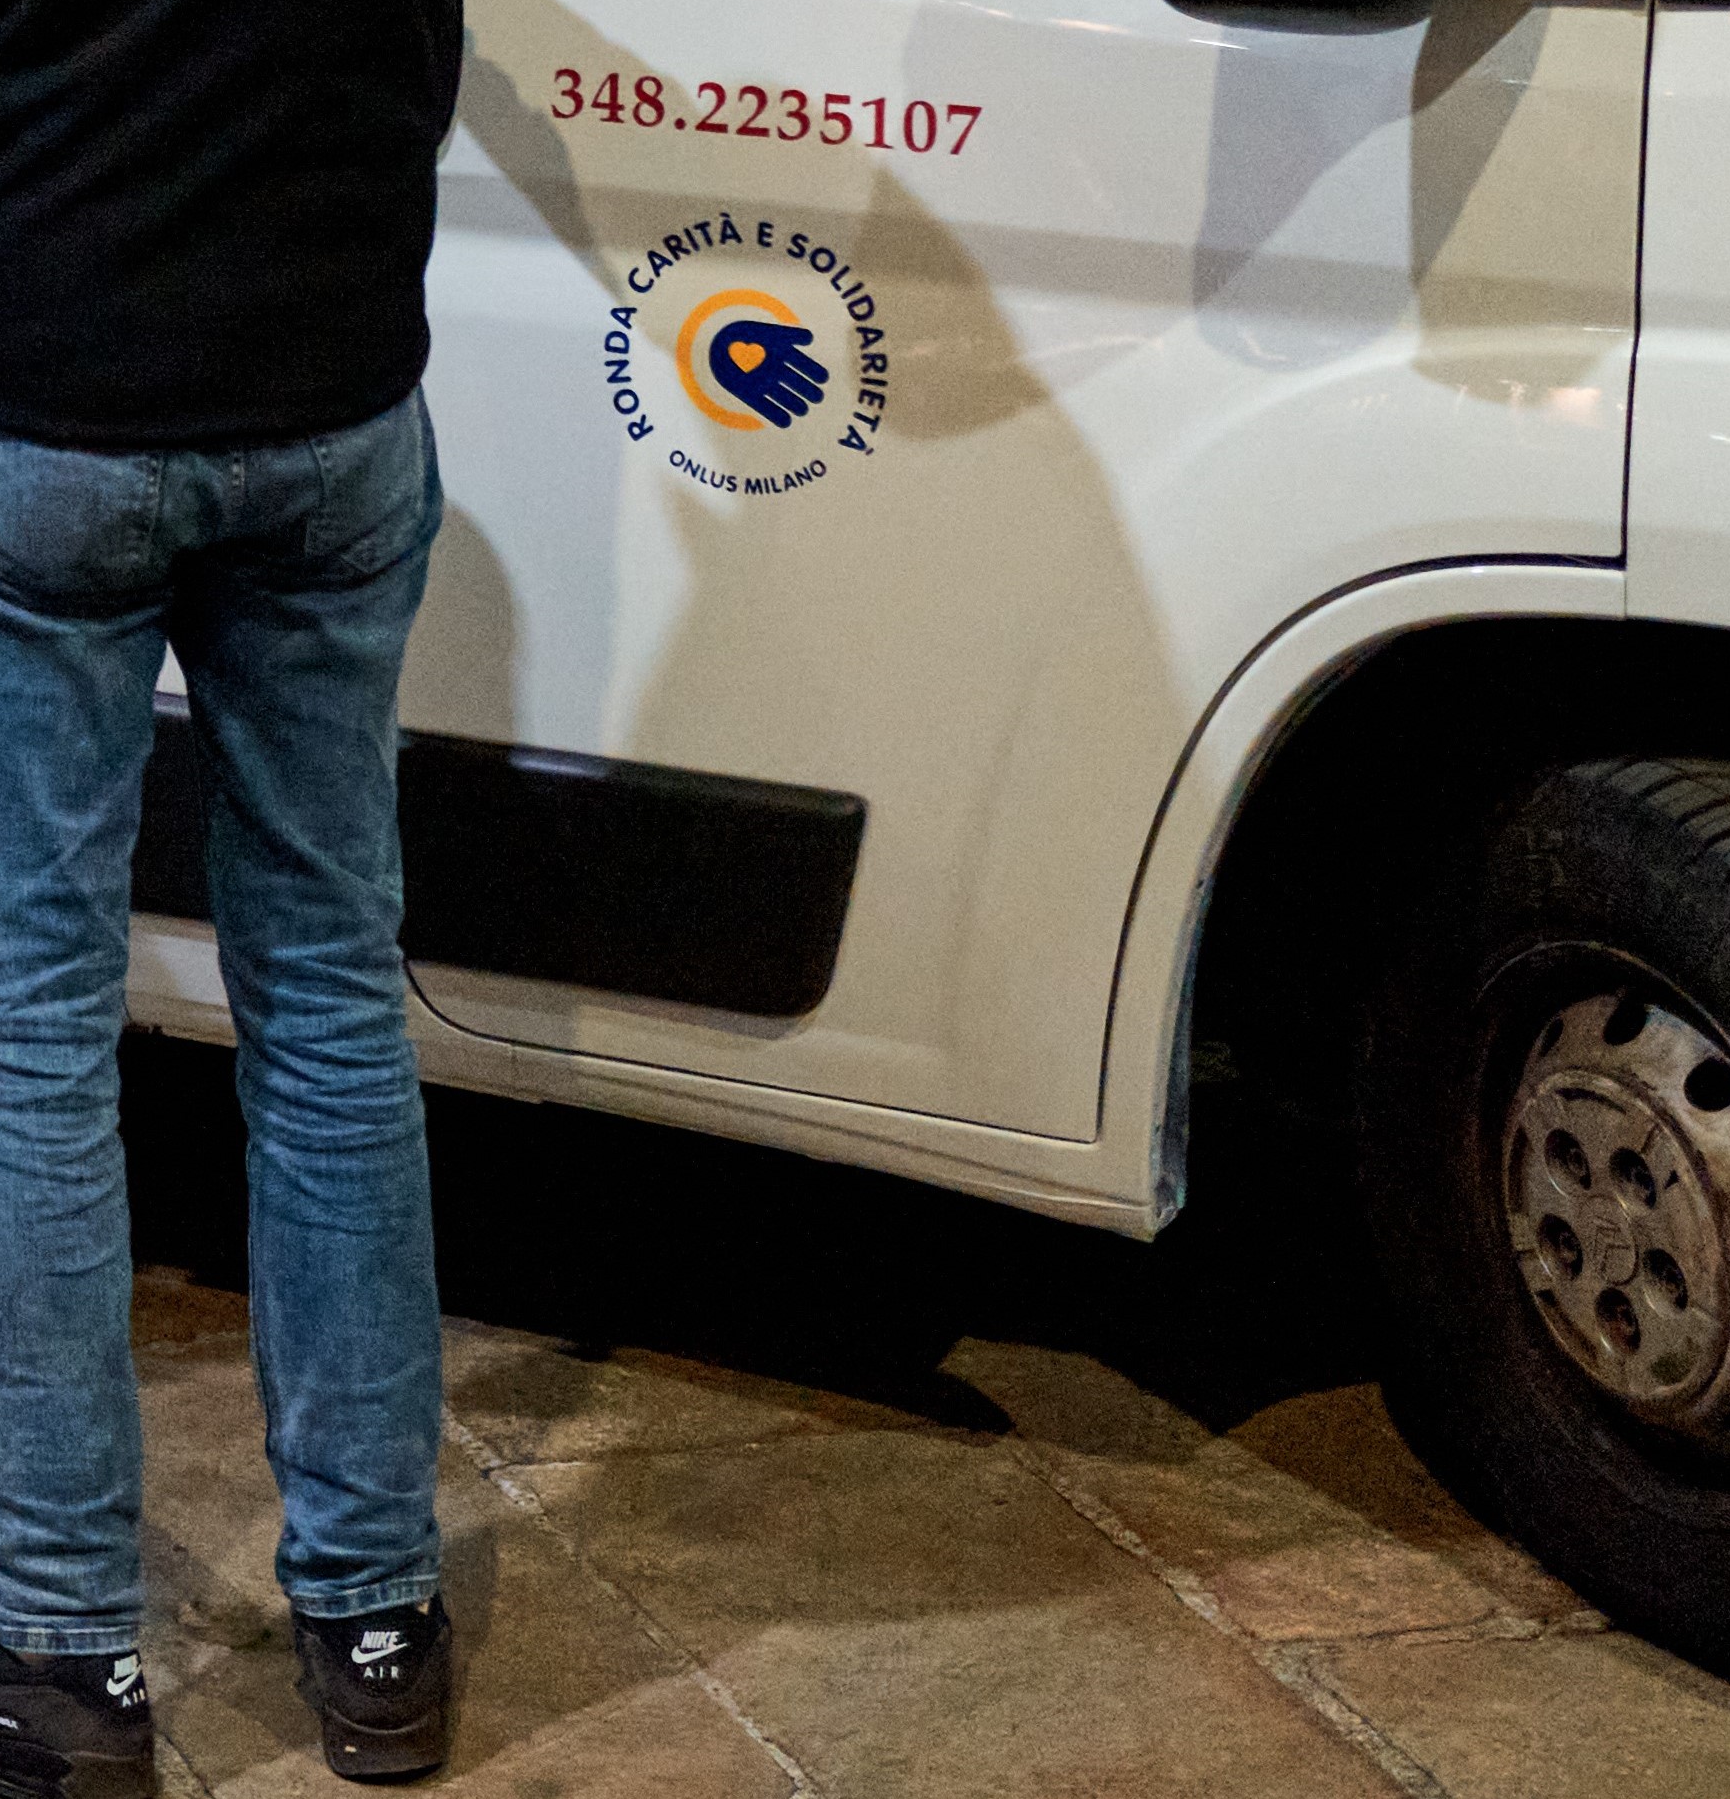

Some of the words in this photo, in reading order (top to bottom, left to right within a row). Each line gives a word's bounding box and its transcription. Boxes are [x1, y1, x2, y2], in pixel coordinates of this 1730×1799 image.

[550, 68, 983, 155] 348.2235107
[627, 212, 743, 294] CARITÀ
[756, 221, 775, 248] E
[603, 305, 654, 442] RONDA
[785, 233, 889, 456] SOLIDARIETÀ
[669, 449, 738, 493] ONLUS
[744, 458, 828, 495] MILANO
[363, 1666, 399, 1679] AIR
